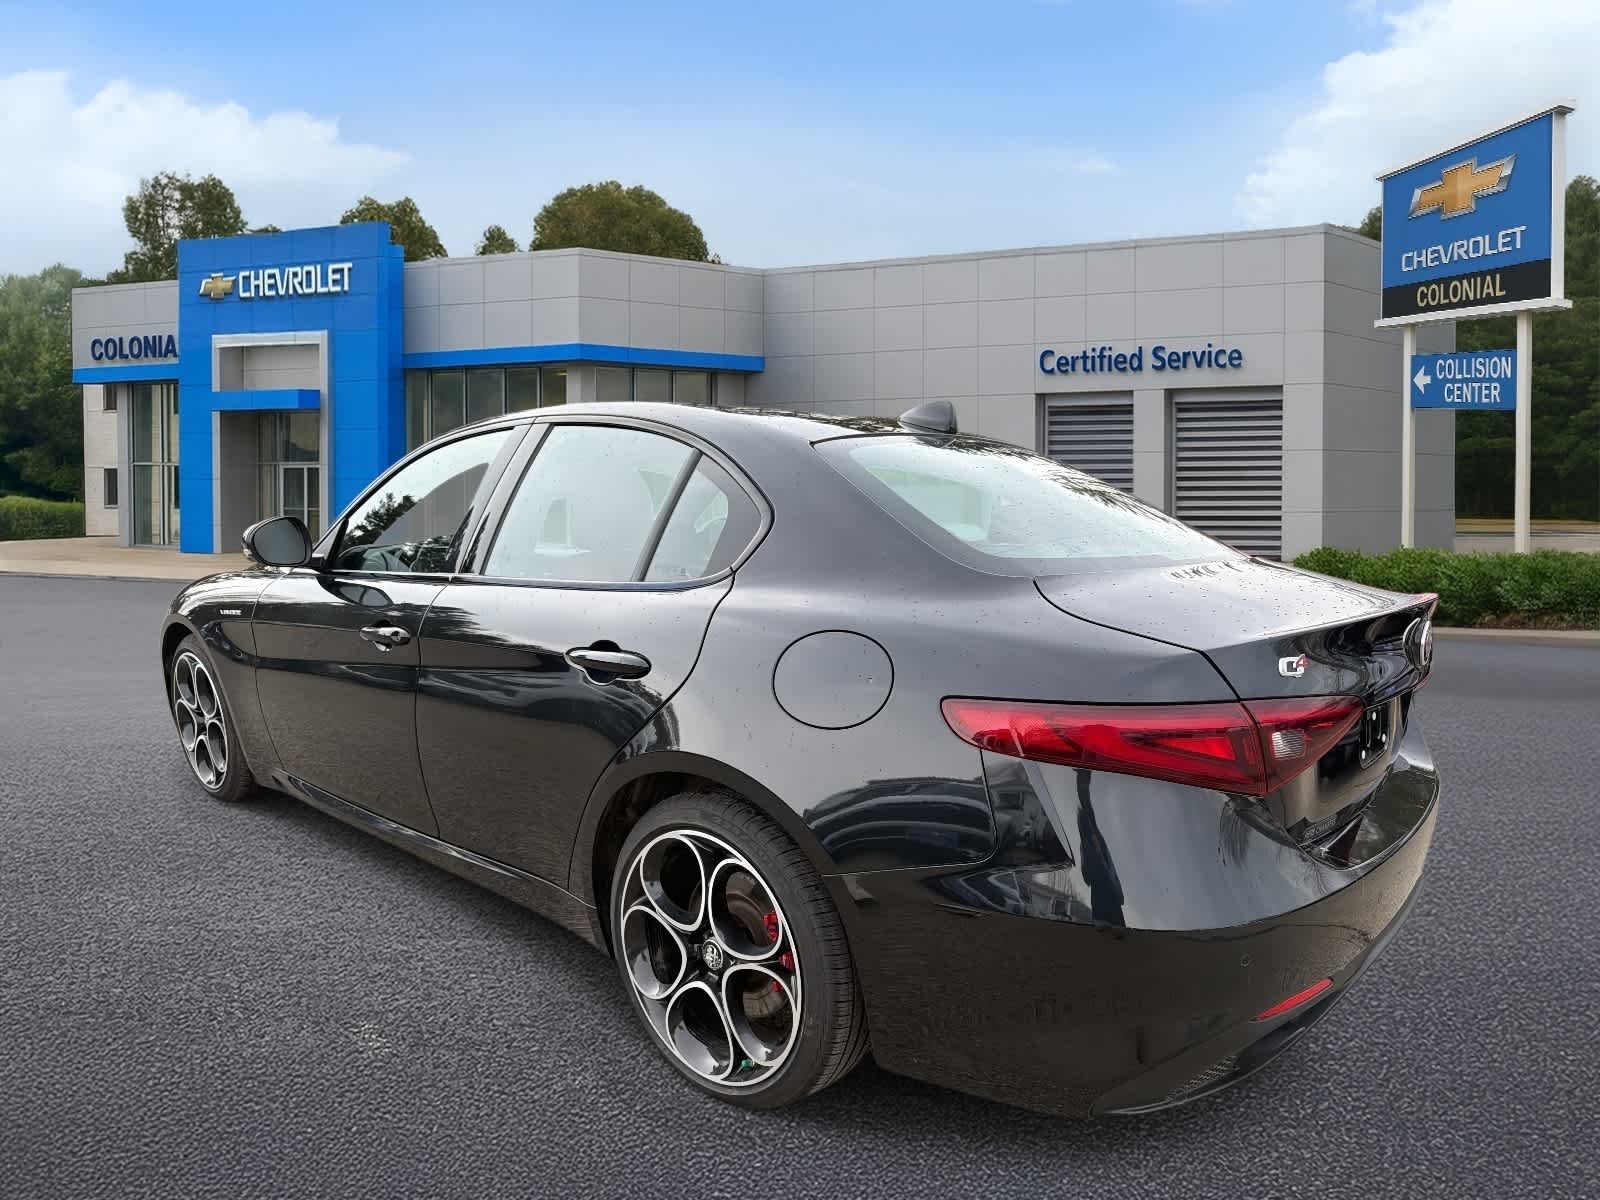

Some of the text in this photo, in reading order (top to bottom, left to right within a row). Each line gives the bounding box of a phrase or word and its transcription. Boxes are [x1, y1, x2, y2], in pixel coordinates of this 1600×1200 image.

[1401, 226, 1527, 272] CHEVROLET
[238, 262, 352, 298] CHEVROLET
[1416, 274, 1506, 307] COLONIAL
[91, 334, 178, 361] COLONIA
[1039, 343, 1243, 374] Certified Service
[1436, 357, 1511, 379] COLLISION
[1444, 382, 1501, 404] CENTER
